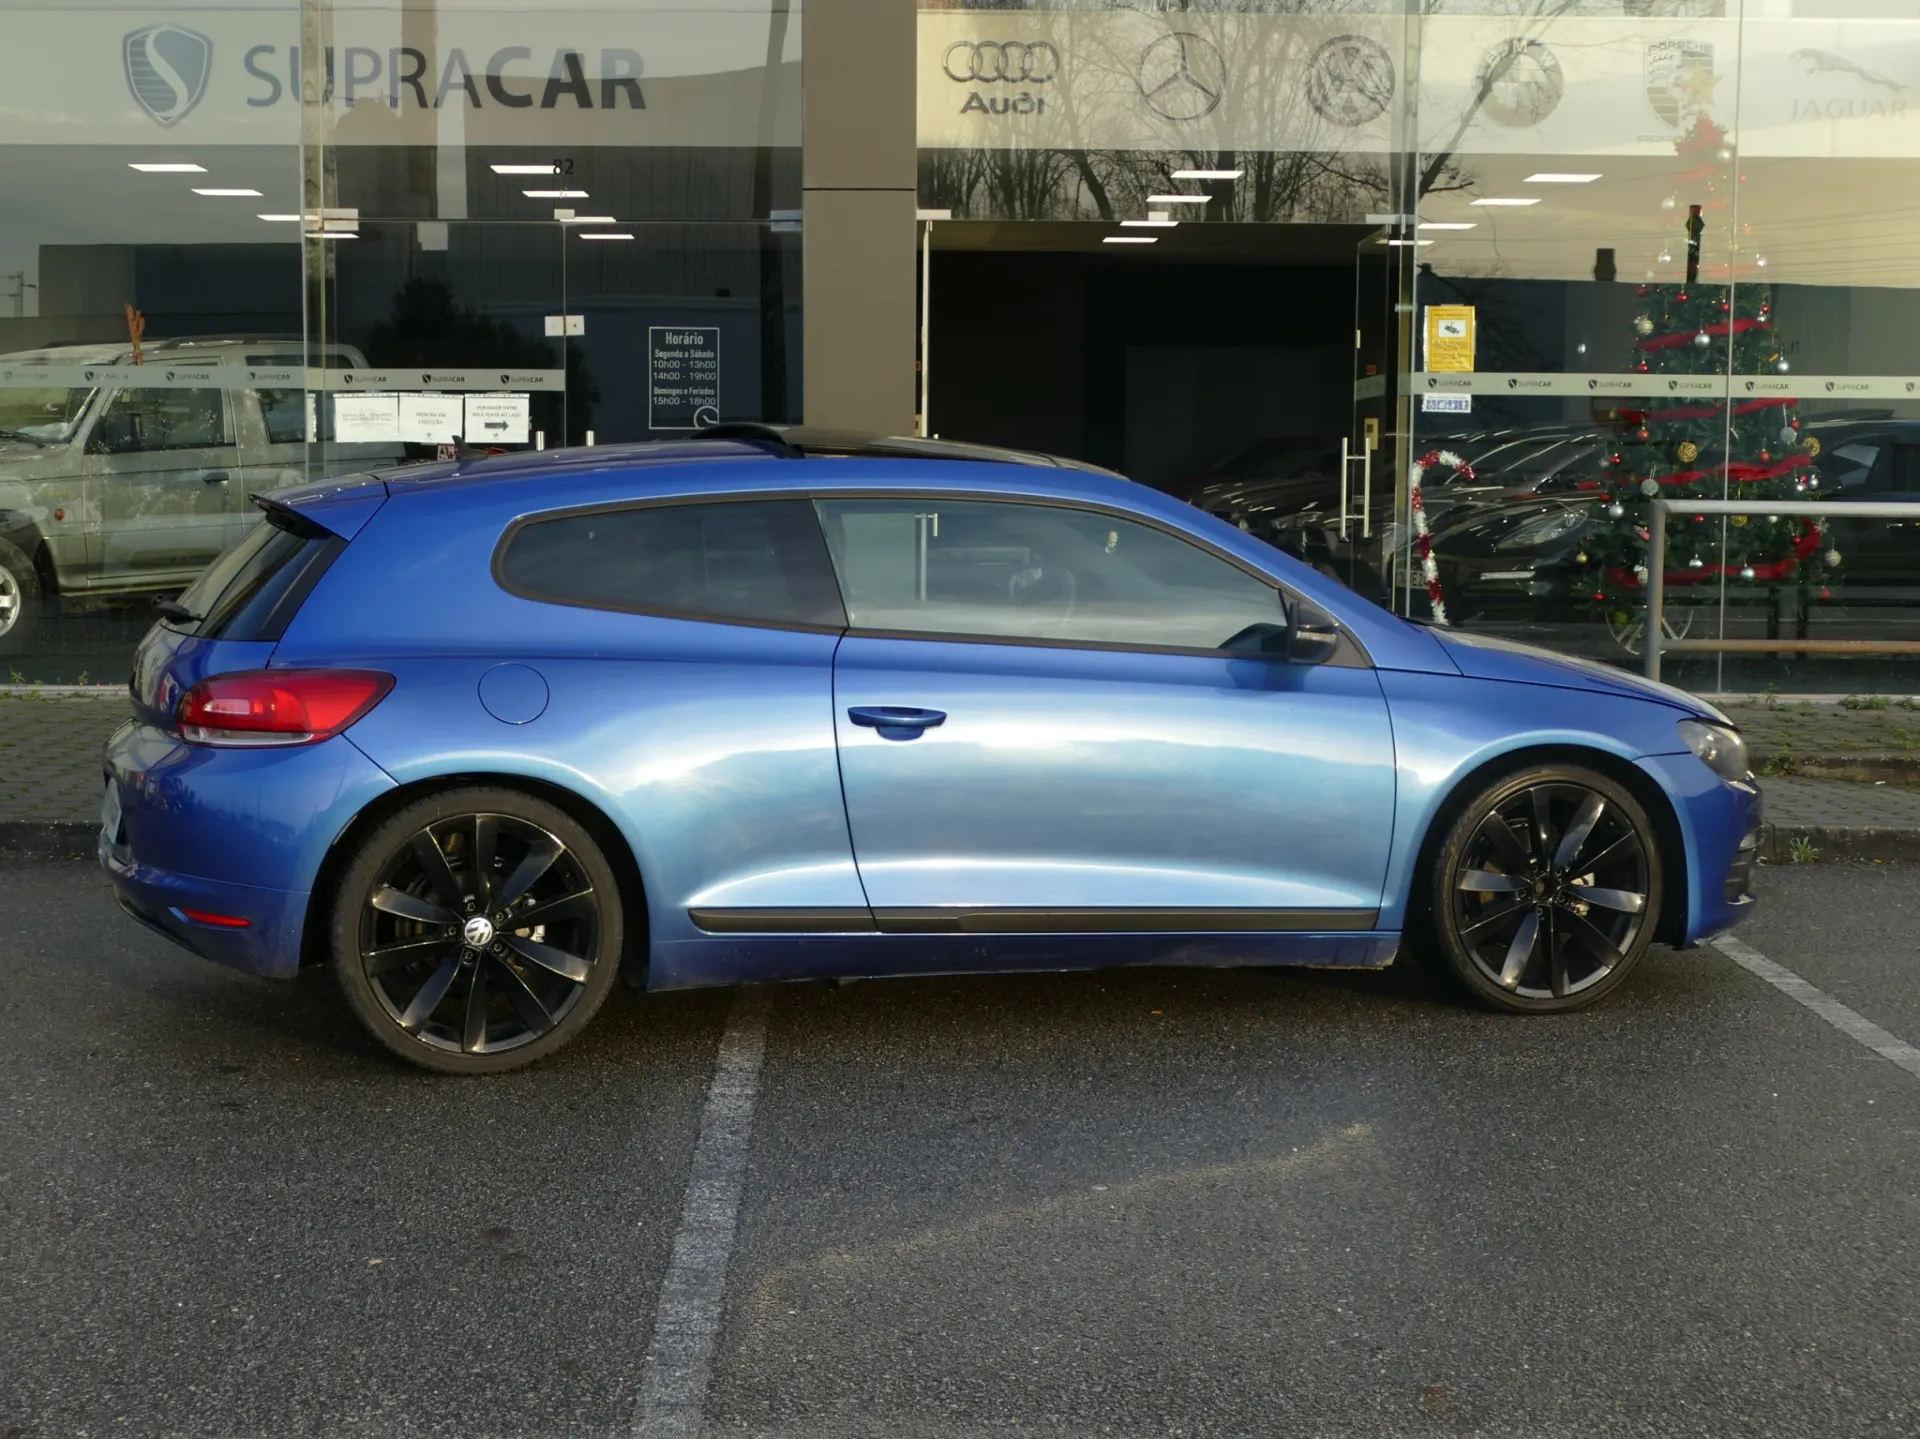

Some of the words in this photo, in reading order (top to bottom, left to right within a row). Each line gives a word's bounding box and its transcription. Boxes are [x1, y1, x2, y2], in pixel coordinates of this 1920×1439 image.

[243, 44, 647, 110] SUPRACAR
[959, 91, 1045, 115] Audi
[1790, 98, 1908, 121] JAGUAR
[553, 158, 574, 176] 82
[665, 331, 704, 345] Horário
[654, 349, 683, 360] Segunda
[690, 349, 715, 359] Sábado
[653, 360, 680, 369] 10h00
[689, 360, 716, 369] 13h00
[653, 372, 680, 381] 14h00
[689, 372, 716, 381] 19h00
[653, 386, 683, 396] Domingos
[653, 397, 680, 406] 15h00
[689, 397, 716, 406] 18h00
